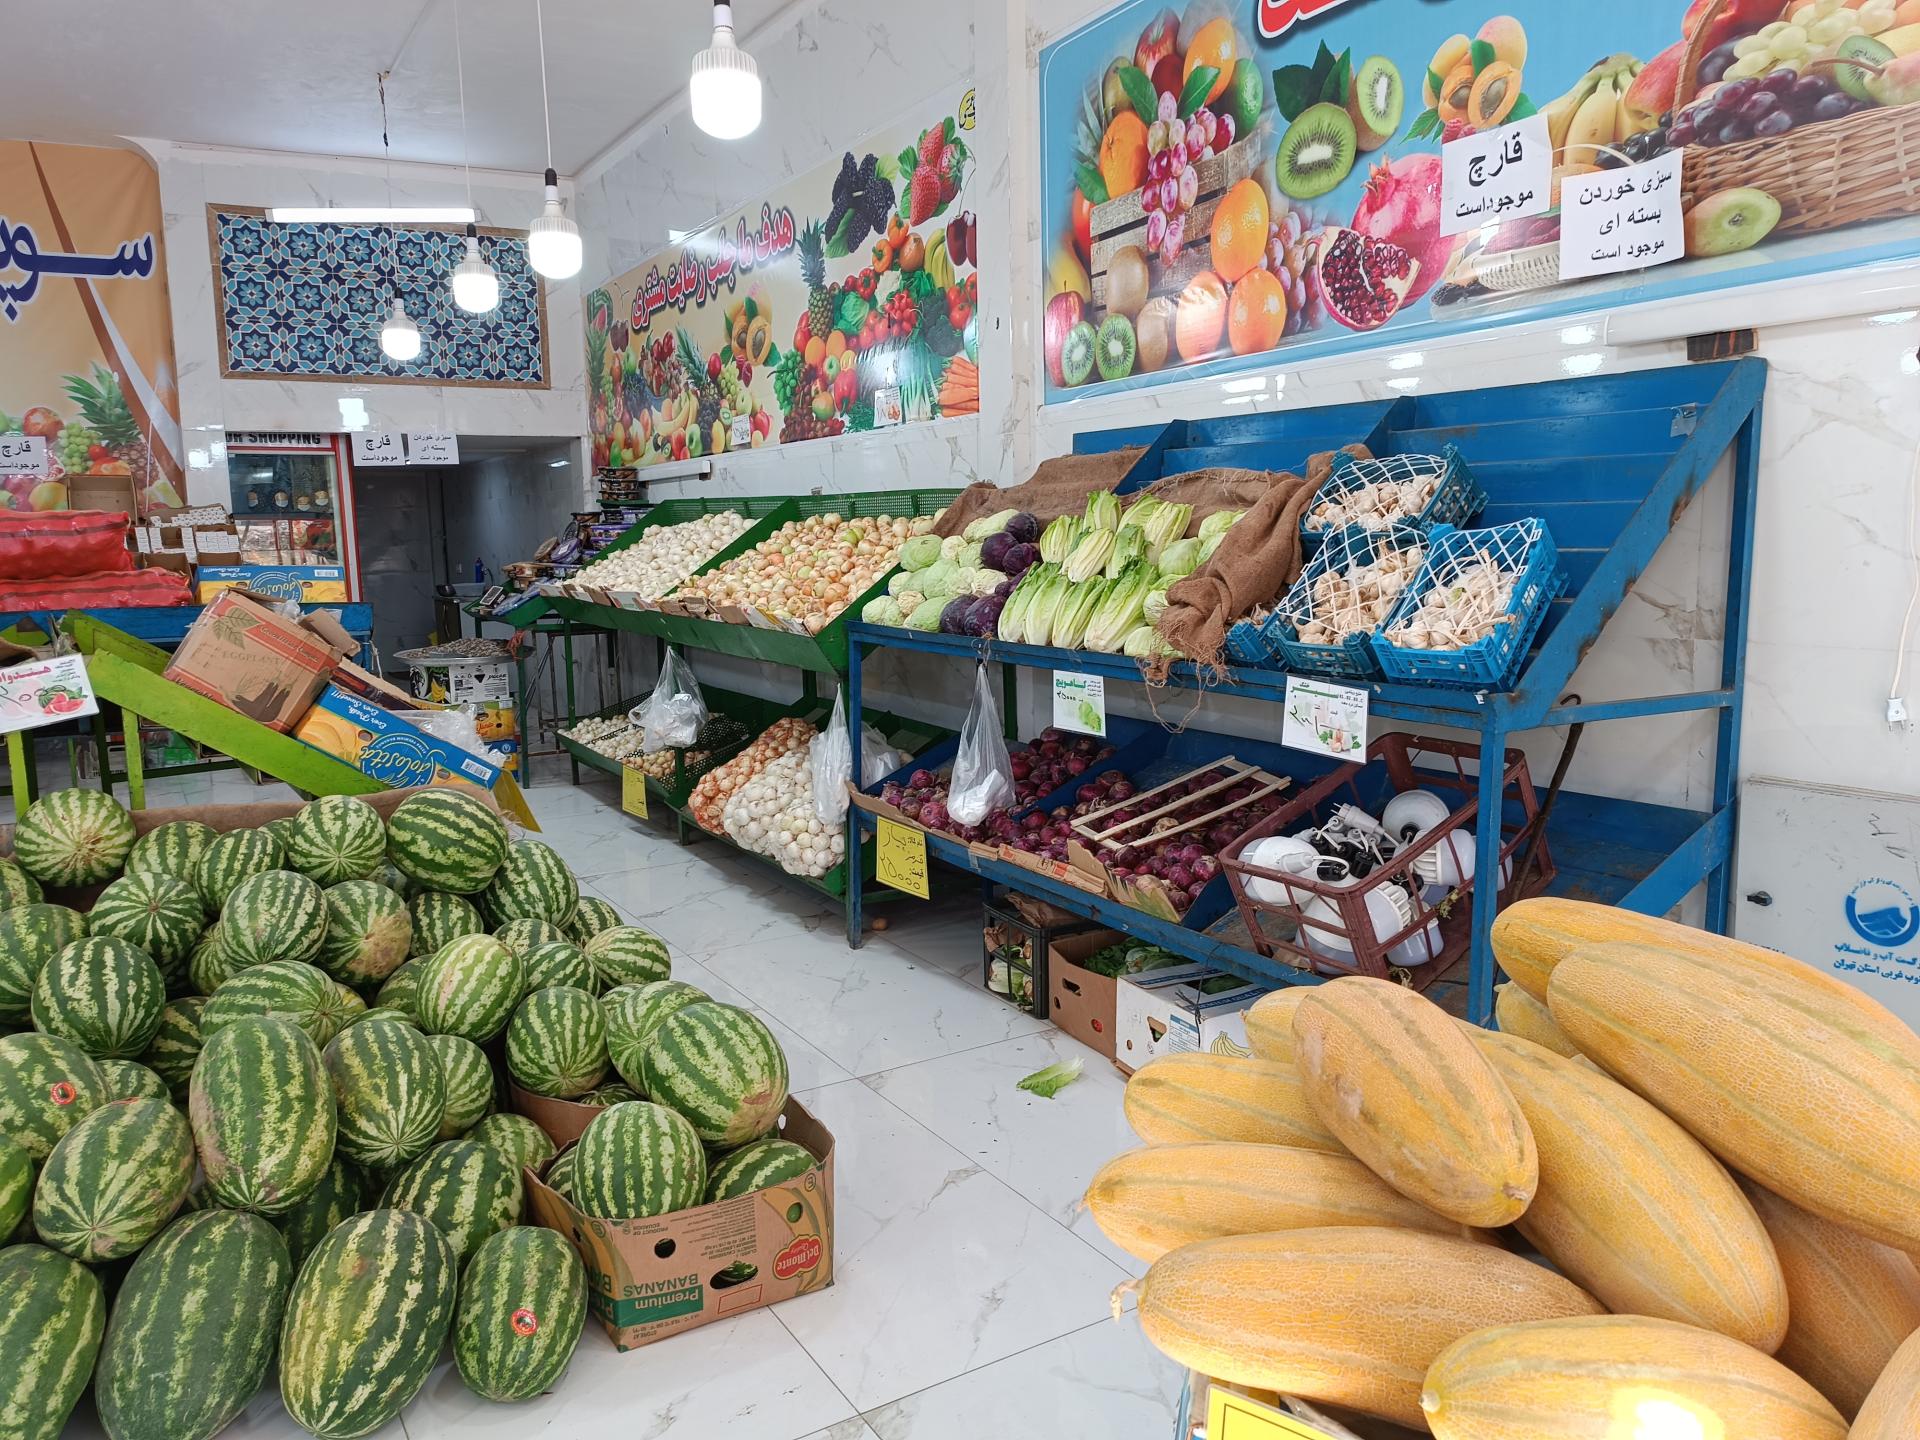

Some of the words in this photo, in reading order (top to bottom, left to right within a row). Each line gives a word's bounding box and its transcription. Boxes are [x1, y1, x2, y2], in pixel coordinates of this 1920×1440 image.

[1468, 131, 1523, 187] قارچ
[1579, 177, 1635, 205] خوردن
[1642, 168, 1673, 194] سبزی
[1599, 210, 1622, 235] ای
[1626, 208, 1662, 227] بسته
[737, 216, 754, 270] ما
[754, 202, 795, 262] هدف
[1590, 248, 1622, 262] است
[1627, 238, 1666, 259] موجود
[706, 228, 738, 295] جلب
[667, 248, 706, 308] رضایت
[631, 265, 666, 330] مشتری
[1, 440, 32, 458] قارچ
[248, 432, 322, 445] SHOPPING
[365, 434, 391, 450] قارچ
[776, 1250, 807, 1271] Monte
[807, 1244, 820, 1256] Del
[623, 1273, 699, 1298] BANANAS
[635, 1287, 699, 1310] Premium
